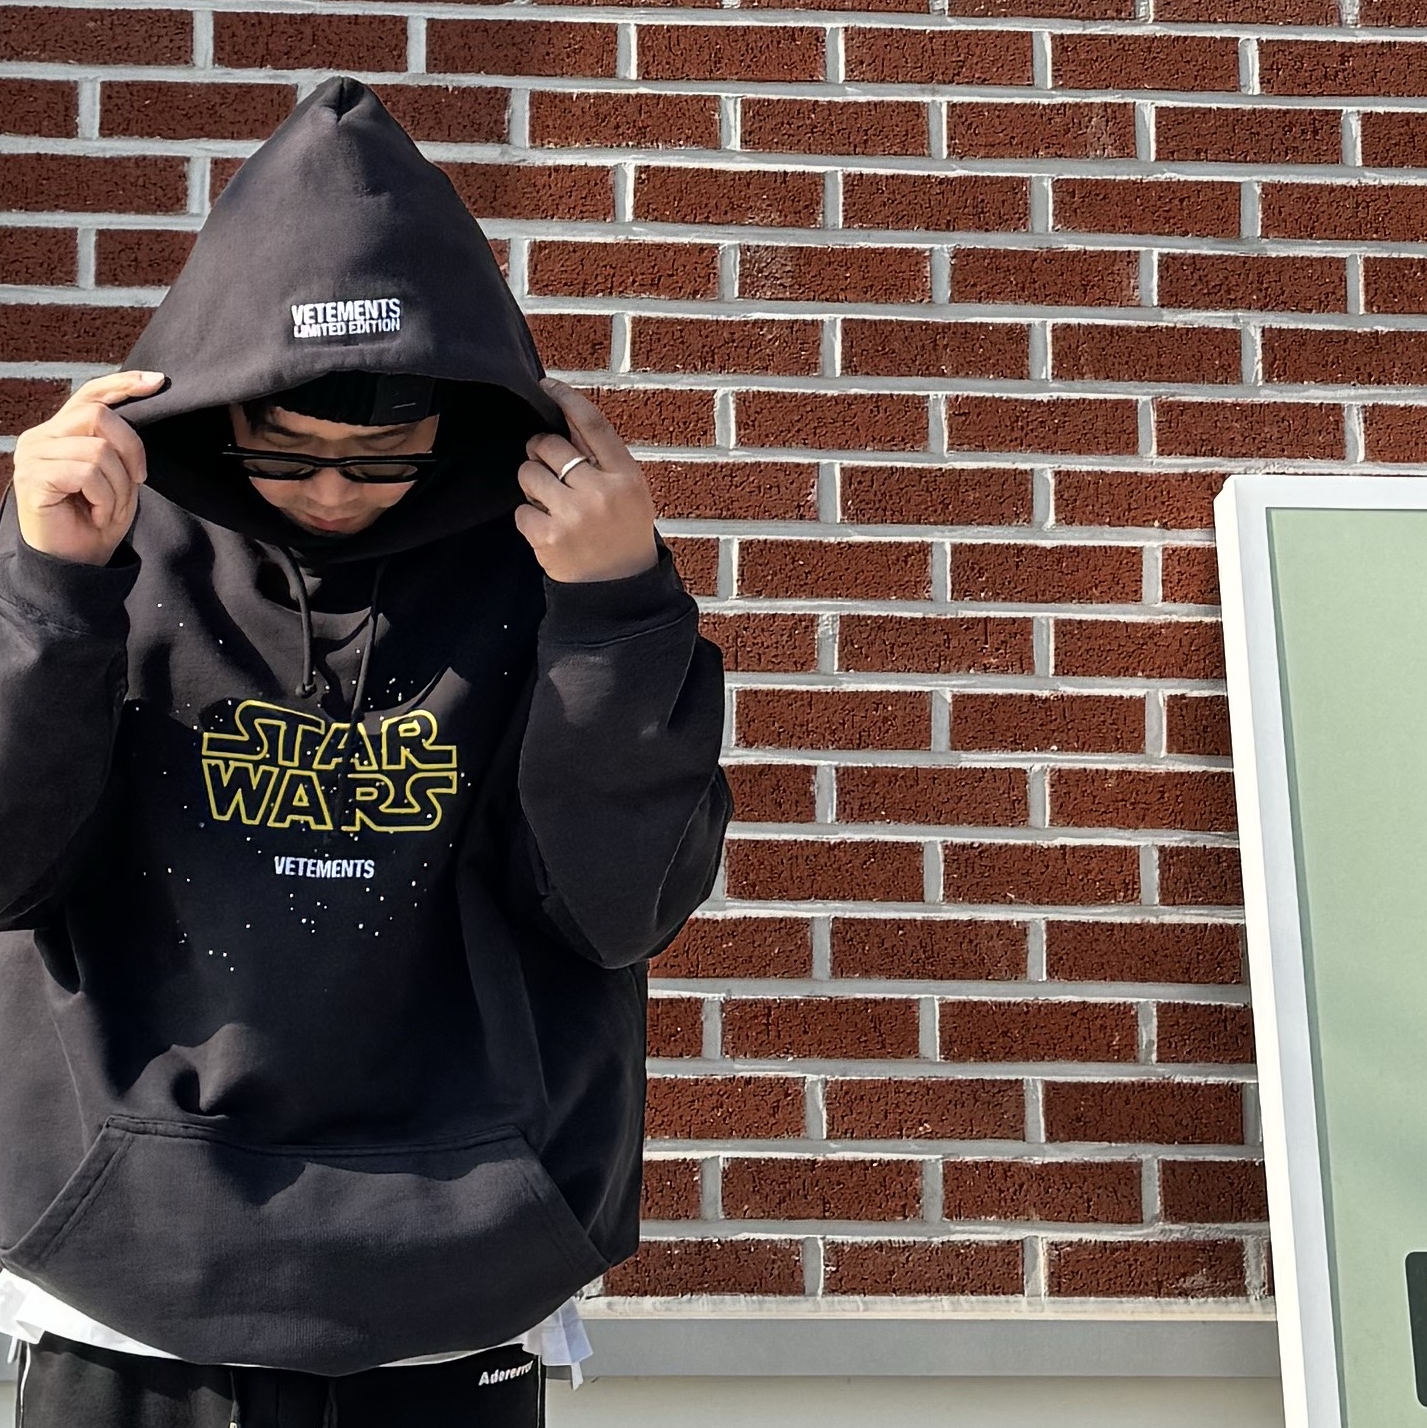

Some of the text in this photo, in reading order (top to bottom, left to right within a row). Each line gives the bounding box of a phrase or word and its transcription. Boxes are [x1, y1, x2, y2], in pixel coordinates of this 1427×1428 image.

[291, 298, 401, 325] VETEMENTS
[293, 317, 401, 338] LIMITED EDITION
[201, 699, 457, 770] STAR
[201, 758, 457, 832] WARS
[274, 856, 375, 879] VETEMENTS
